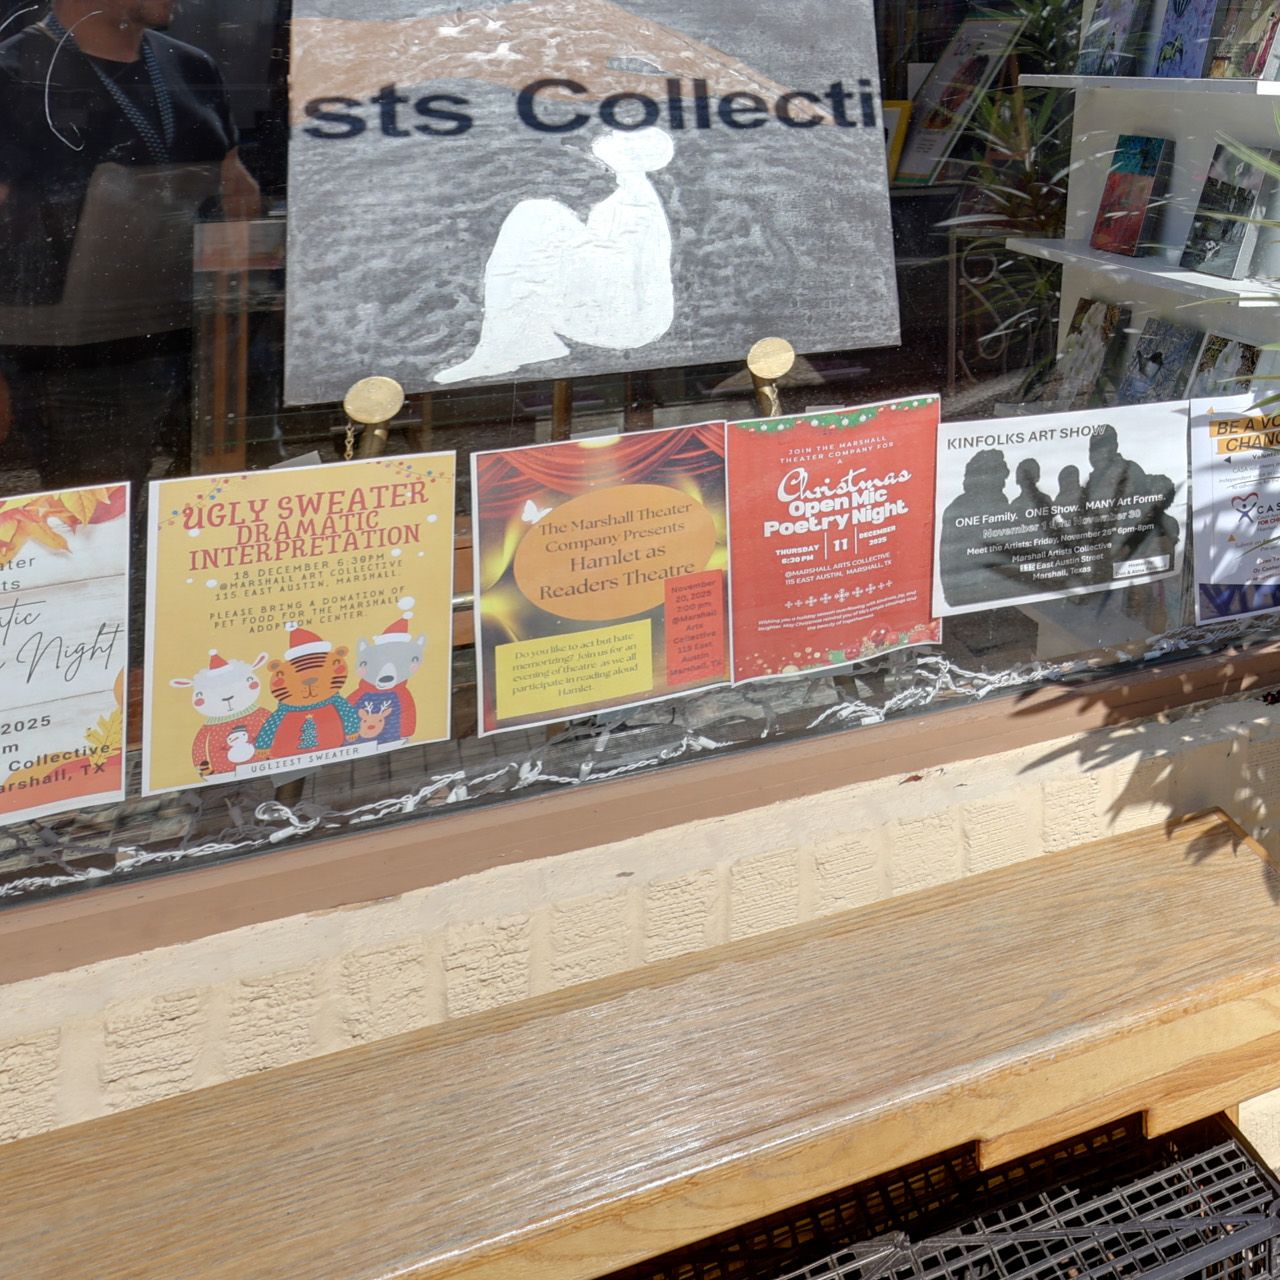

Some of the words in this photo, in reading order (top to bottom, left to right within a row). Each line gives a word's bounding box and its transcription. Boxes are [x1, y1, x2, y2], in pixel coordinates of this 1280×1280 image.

[304, 84, 474, 139] sts
[516, 77, 877, 134] Collecti
[947, 432, 1024, 450] KINFOLKS
[1028, 429, 1057, 443] ART
[1059, 424, 1107, 439] SHOW
[1217, 420, 1240, 435] BE
[1244, 418, 1255, 432] A
[780, 453, 825, 464] THEATER
[828, 446, 873, 458] COMPANY
[877, 441, 894, 449] FOR
[789, 447, 812, 455] JOIN
[839, 436, 887, 448] MARSHALL
[777, 467, 912, 502] Christmas
[182, 498, 269, 531] UGLY
[277, 480, 429, 520] SWEATER
[788, 496, 849, 518] Open
[851, 487, 888, 507] Mic
[955, 515, 980, 528] ONE
[981, 511, 1018, 526] Family.
[1025, 506, 1049, 518] ONE
[1050, 503, 1081, 515] Show.
[1086, 498, 1115, 511] MANY
[1117, 497, 1132, 506] Art
[1133, 493, 1166, 505] Forms.
[236, 510, 379, 546] DRAMATIC
[538, 522, 568, 536] The
[570, 510, 634, 531] Marshall
[637, 503, 693, 521] Theater
[763, 513, 850, 538] Poetry
[851, 500, 909, 525] Night
[858, 525, 896, 539] DECEMBER
[982, 522, 1039, 539] November
[189, 523, 421, 571] INTERPRETATION
[545, 534, 620, 553] Company
[623, 522, 686, 541] Presents
[775, 544, 820, 556] THURSDAY
[832, 538, 849, 552] 11
[571, 548, 641, 572] Hamlet
[646, 545, 666, 559] as
[784, 565, 831, 578] @MARSHALL
[832, 561, 851, 570] ARTS
[852, 551, 891, 566] COLLECTIVE
[801, 554, 814, 562] PM
[967, 547, 988, 556] Meet
[1012, 552, 1046, 564] Marshall
[1073, 542, 1112, 554] Collective
[1036, 561, 1054, 570] East
[1055, 556, 1080, 567] Austin
[219, 574, 294, 591] @MARSHALL
[301, 571, 324, 581] ART
[330, 559, 403, 577] COLLECTIVE
[233, 571, 250, 581] 18
[258, 560, 330, 578] DECEMBER
[337, 553, 385, 568] 6:30PM
[796, 576, 815, 584] EAST
[1070, 565, 1091, 575] Texas
[215, 592, 237, 601] 115
[244, 587, 273, 598] EAST
[540, 577, 619, 600] Readers
[623, 562, 696, 586] Theatre
[210, 607, 254, 621] PLEASE
[260, 601, 303, 615] BRING
[322, 588, 385, 606] DONATION
[392, 585, 406, 595] OF
[214, 619, 235, 629] PET
[242, 614, 275, 626] FOOD
[282, 610, 305, 620] FOR
[312, 606, 333, 616] THE
[340, 595, 400, 612] MARSHALL
[249, 618, 313, 634] ADOPTION
[16, 622, 125, 684] Night
[0, 715, 51, 735] 2025
[8, 744, 110, 772] Collective
[80, 762, 106, 776] TX
[251, 757, 302, 773] UGLIEST
[309, 747, 360, 763] SWEATER
